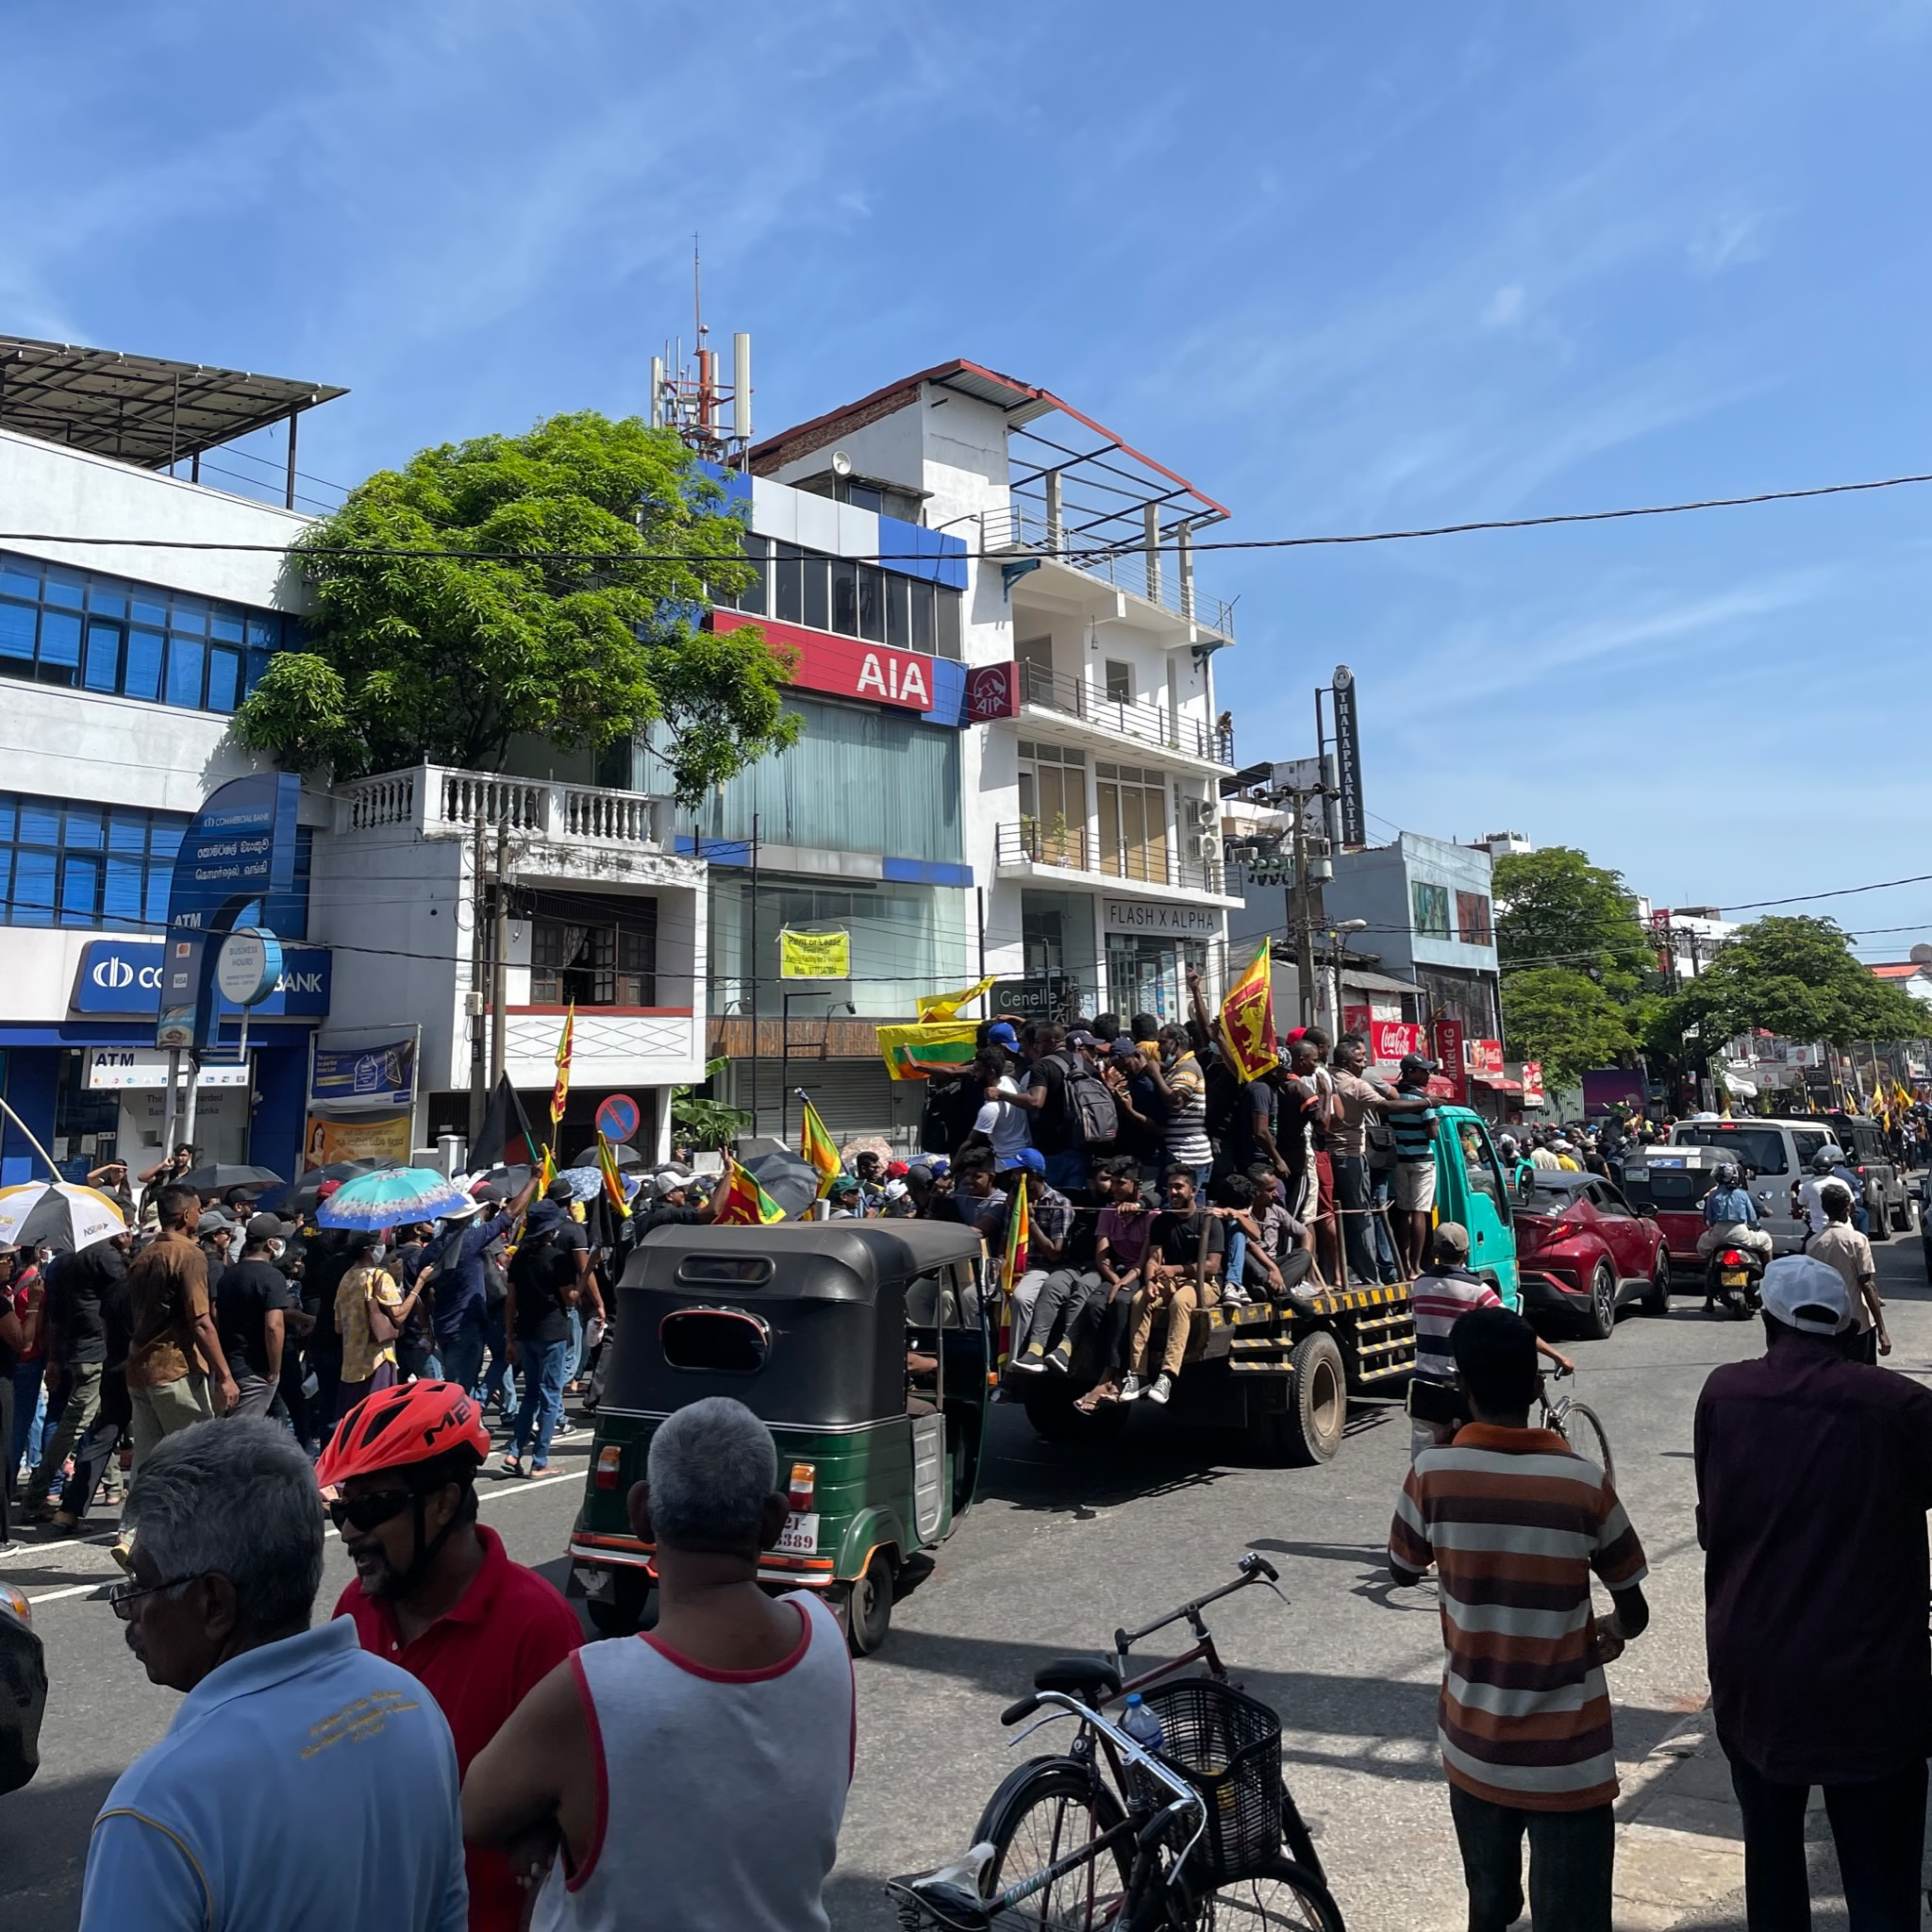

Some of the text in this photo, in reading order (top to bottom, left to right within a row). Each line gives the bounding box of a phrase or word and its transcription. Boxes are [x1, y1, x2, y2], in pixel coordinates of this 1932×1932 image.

[856, 653, 929, 705] AIA
[975, 695, 1005, 714] AIA
[1338, 691, 1357, 842] THALAPPAKATTI
[173, 912, 202, 929] ATM
[1110, 906, 1214, 930] FLASH X ALPHA
[788, 936, 807, 946] Rent
[819, 938, 841, 946] Lease
[229, 945, 258, 956] BUSINESS
[232, 958, 253, 967] HOURS
[175, 976, 187, 985] VISA
[1000, 988, 1058, 1008] Genelle
[1443, 1028, 1455, 1046] 4G
[94, 1053, 135, 1067] ATM
[1445, 1048, 1457, 1080] airtel
[145, 1094, 162, 1103] The
[148, 1108, 165, 1116] Ban
[424, 1394, 472, 1447] MET
